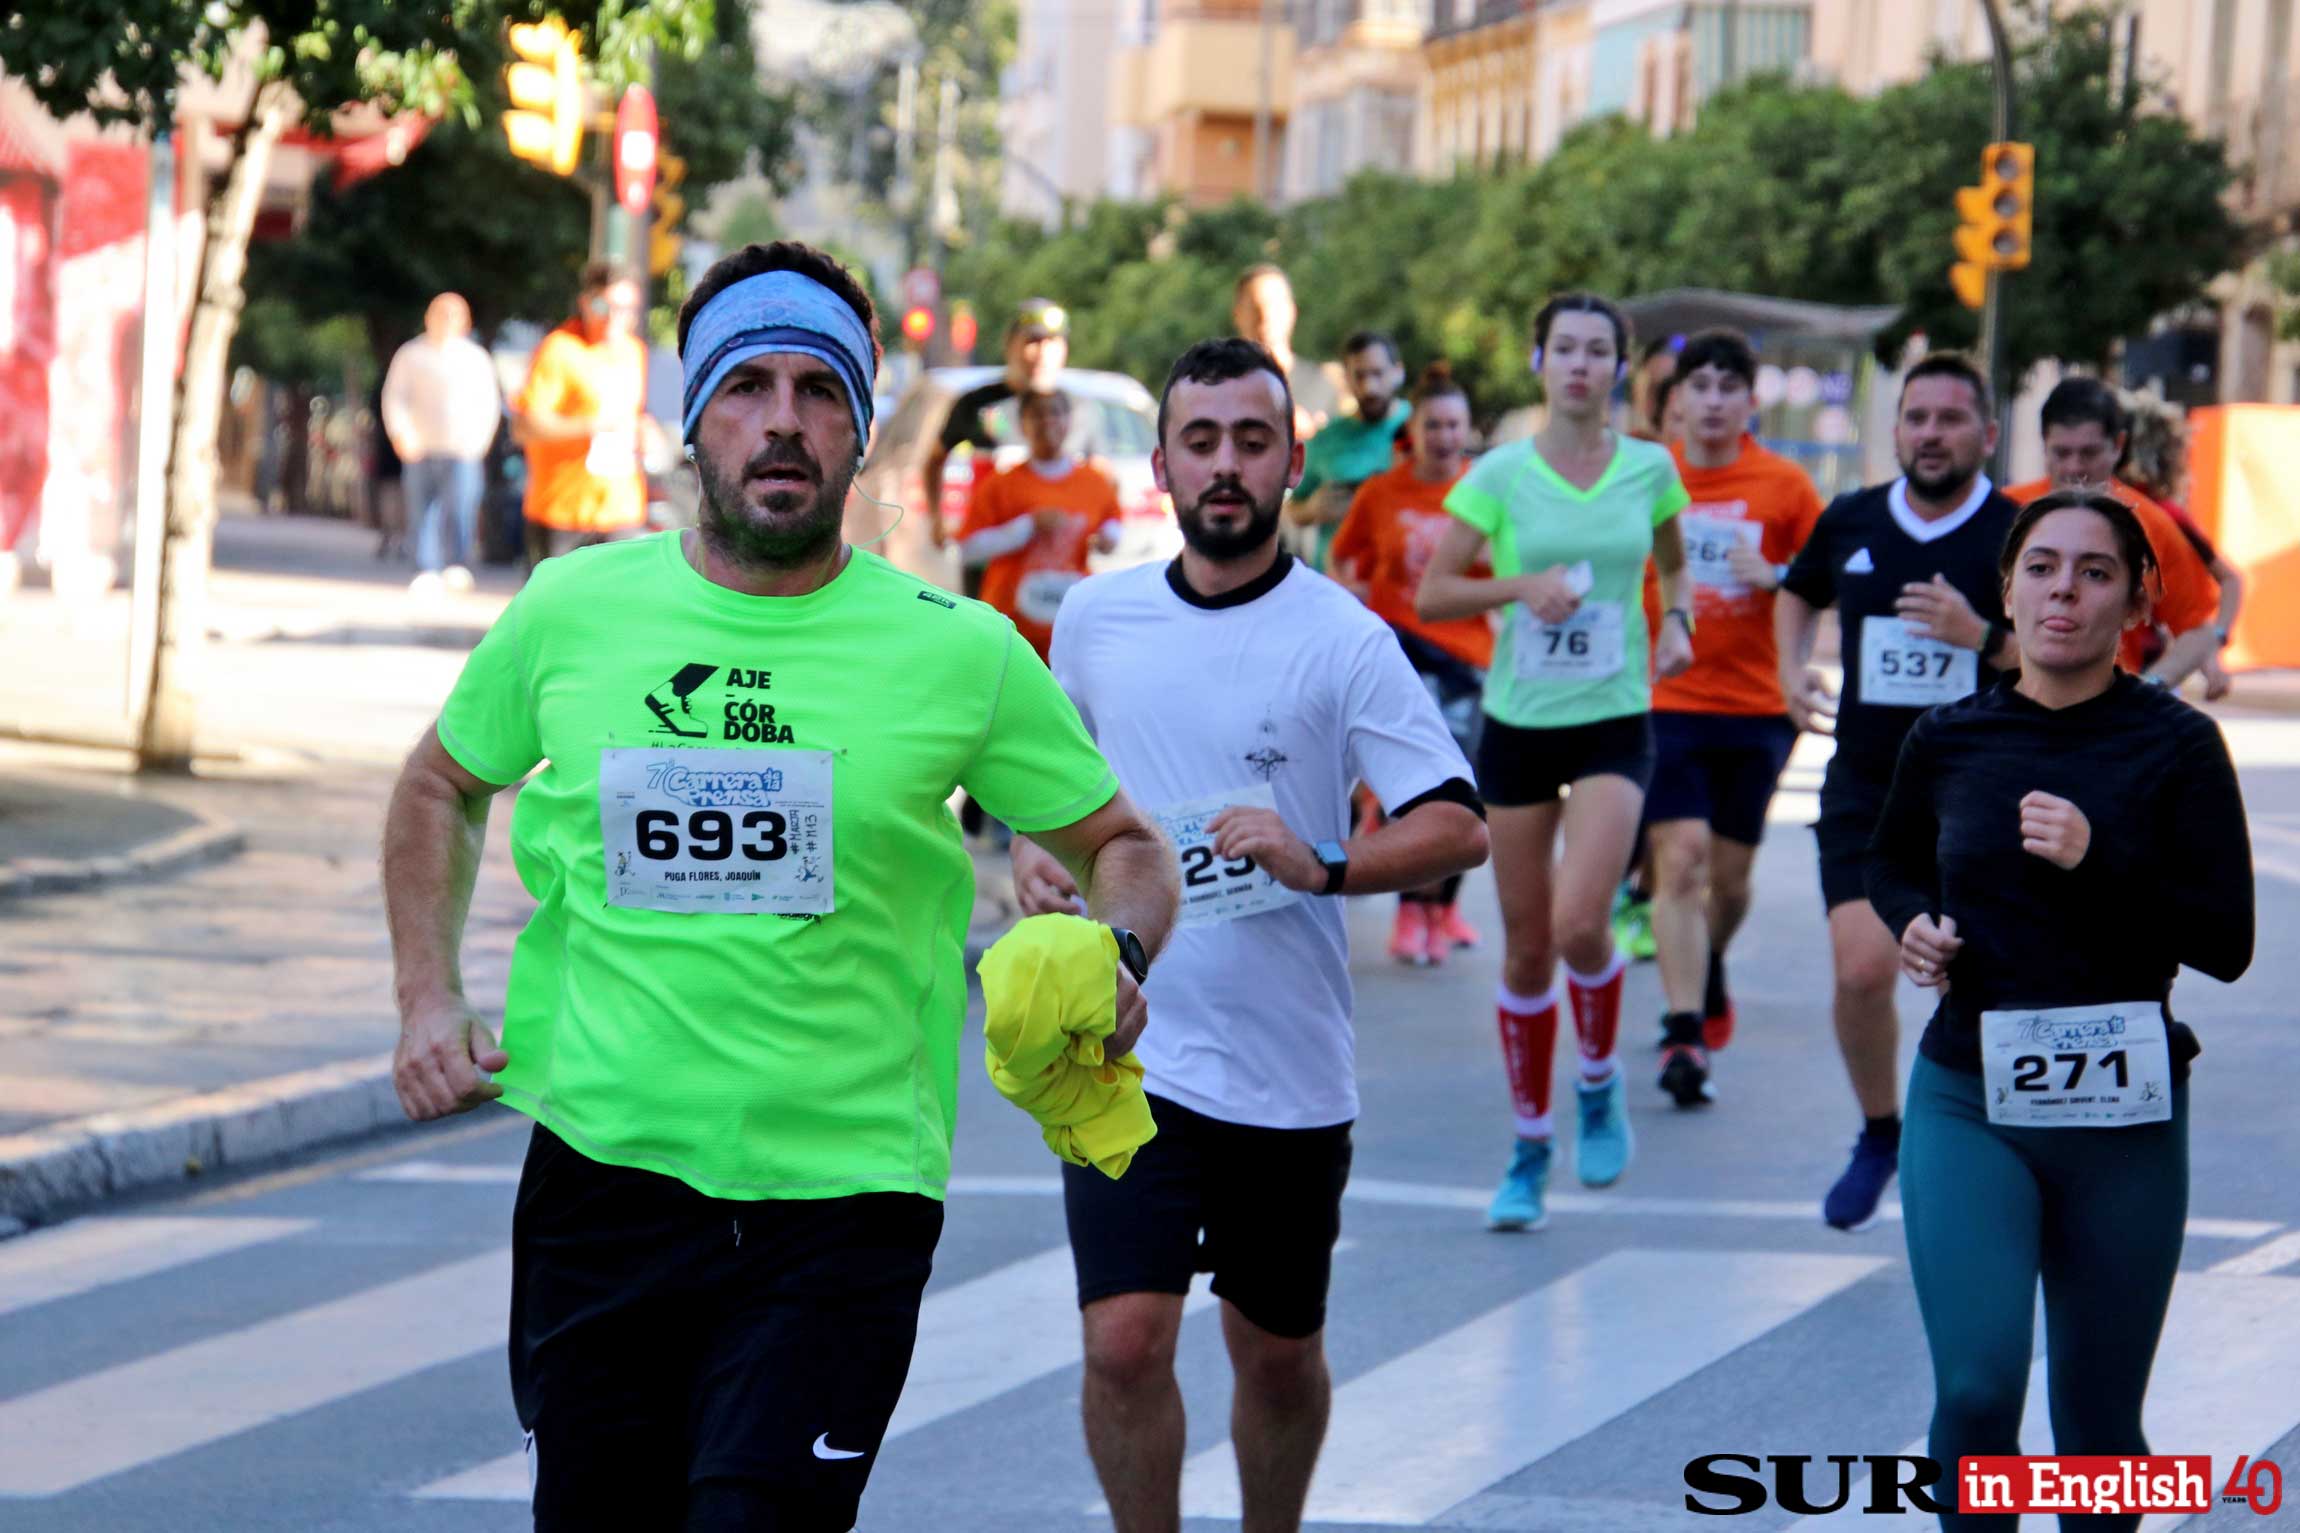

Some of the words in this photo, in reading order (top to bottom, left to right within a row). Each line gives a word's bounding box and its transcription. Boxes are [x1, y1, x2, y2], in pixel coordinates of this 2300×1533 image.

[1542, 631, 1590, 656] 76
[1882, 649, 1954, 678] 537
[726, 668, 772, 689] AJE
[724, 698, 775, 723] CÓR
[723, 720, 795, 744] DOBA
[663, 766, 762, 792] Carrera
[636, 810, 788, 861] 693
[664, 871, 687, 882] PUGA
[689, 871, 722, 882] FLORES,
[725, 870, 761, 881] JOAQUÍN
[2013, 1050, 2129, 1092] 271
